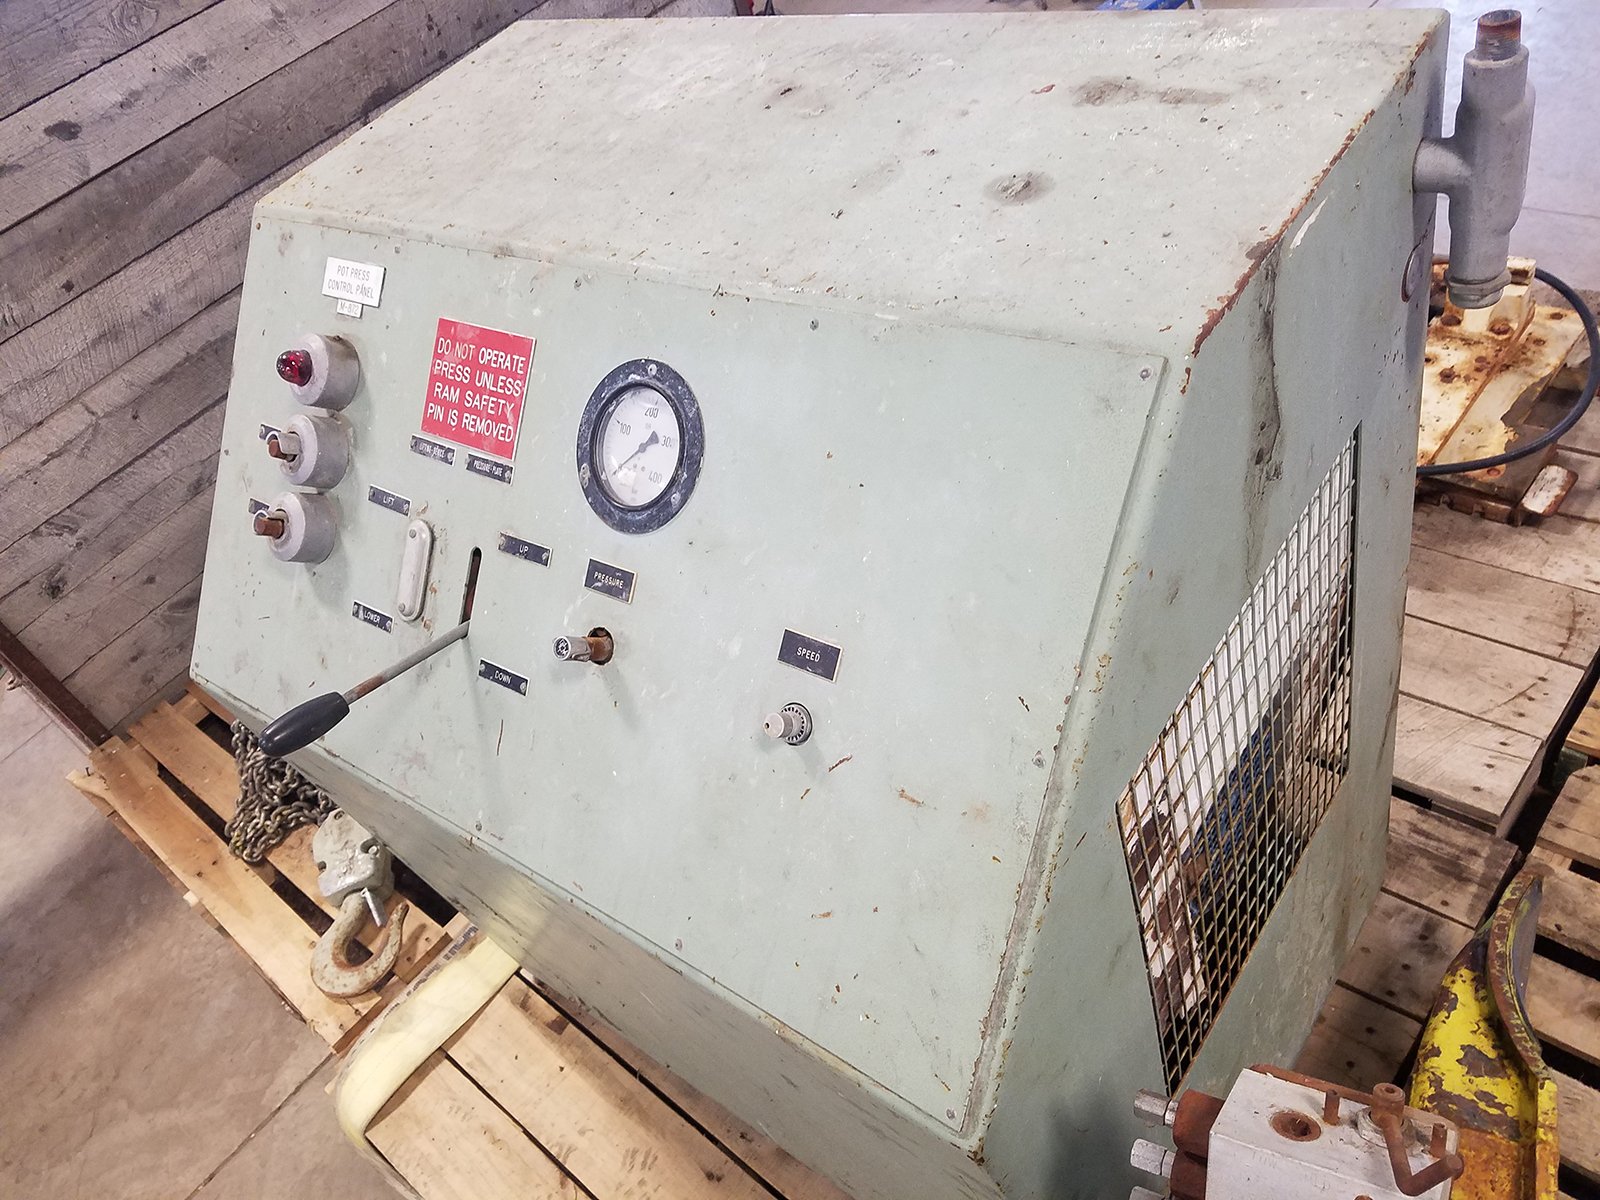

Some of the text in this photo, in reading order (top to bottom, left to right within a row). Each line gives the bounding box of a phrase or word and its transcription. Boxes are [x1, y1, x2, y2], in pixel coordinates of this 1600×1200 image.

[337, 265, 370, 281] POT PRESS
[328, 279, 374, 299] CONTROL PANEL
[437, 337, 526, 374] DO NOT OPERATE
[434, 360, 522, 397] PRESS UNLESS
[434, 382, 515, 418] RAM SAFETY
[644, 407, 659, 419] 200
[427, 403, 514, 442] PIN IS REMOVED
[619, 423, 631, 435] 100
[648, 471, 662, 484] 400
[519, 544, 529, 553] UP
[593, 571, 624, 589] PRESSURE
[364, 610, 380, 623] LOWER
[796, 646, 820, 662] SPEED
[494, 670, 511, 684] DOWN
